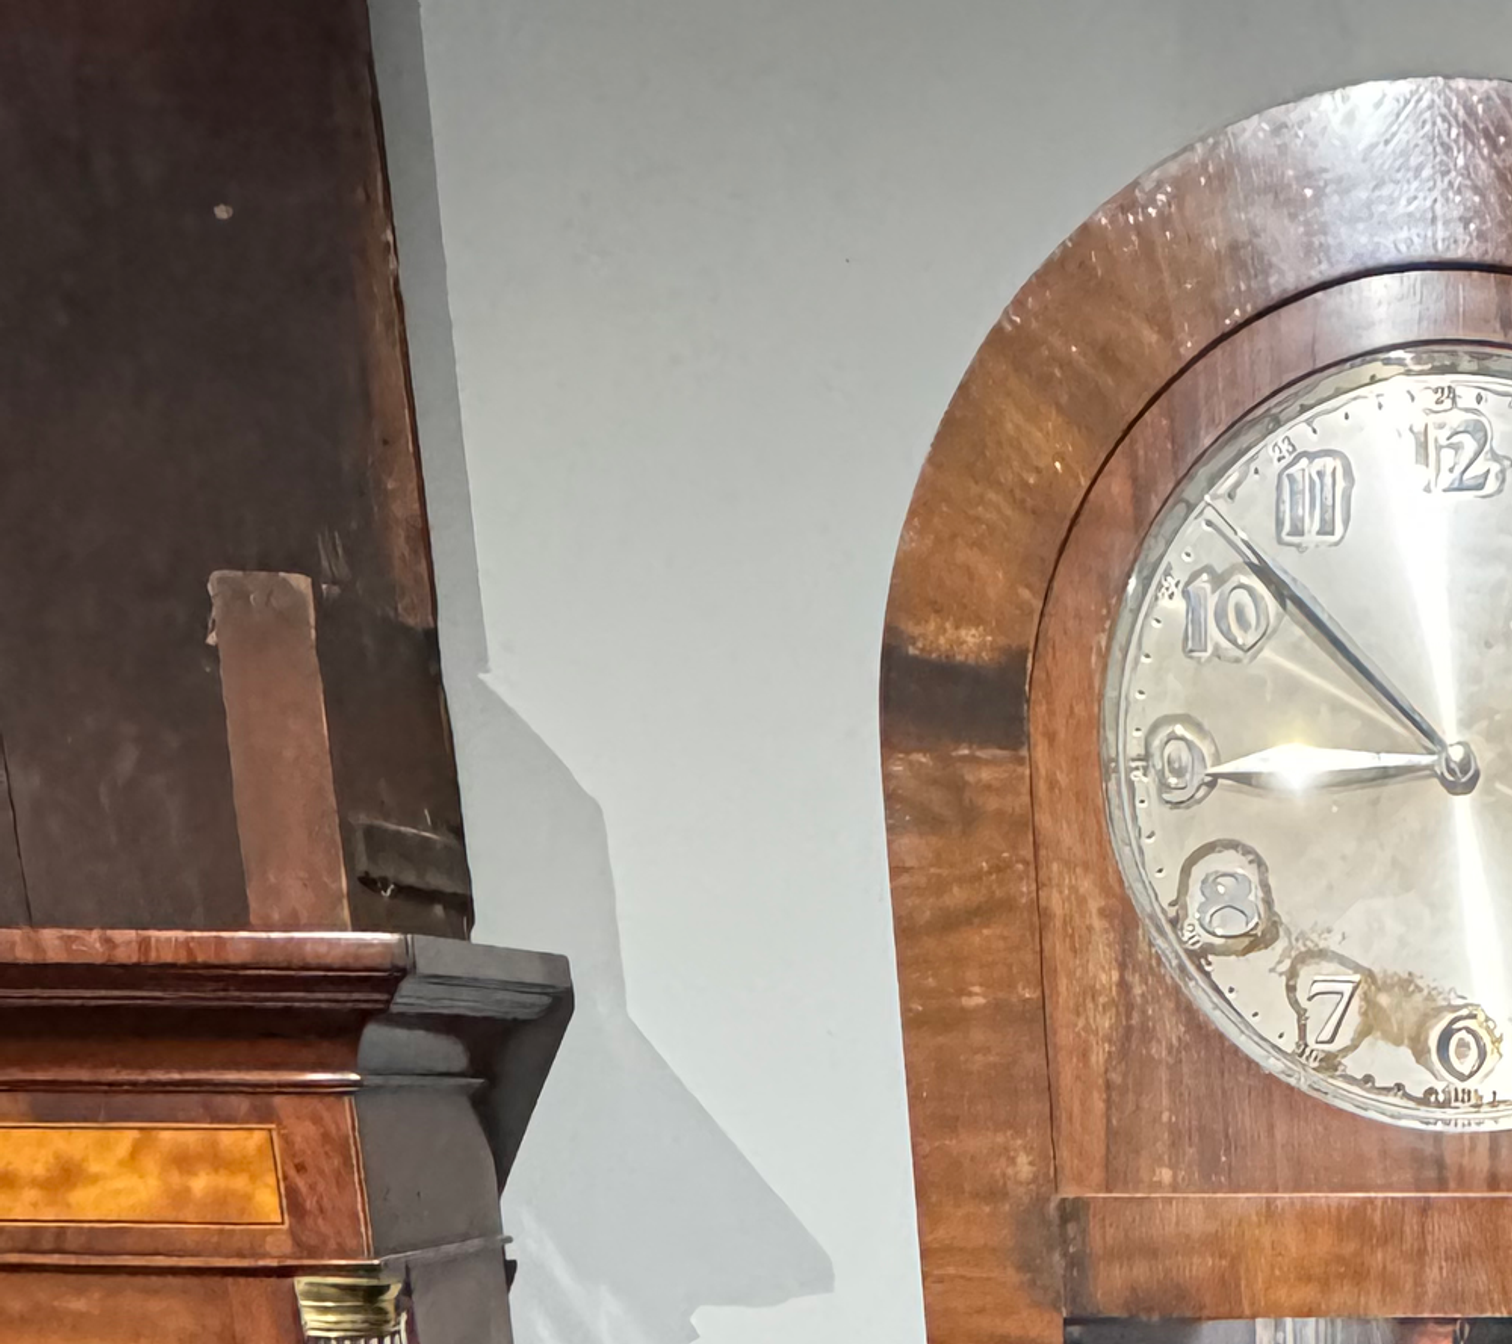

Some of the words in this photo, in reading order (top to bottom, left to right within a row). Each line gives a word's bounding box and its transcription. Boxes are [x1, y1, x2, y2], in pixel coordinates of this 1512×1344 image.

[1410, 418, 1491, 492] 12
[1284, 458, 1338, 537] 11
[1184, 576, 1270, 653] 10
[1197, 870, 1259, 938] 8
[1307, 974, 1362, 1045] 7
